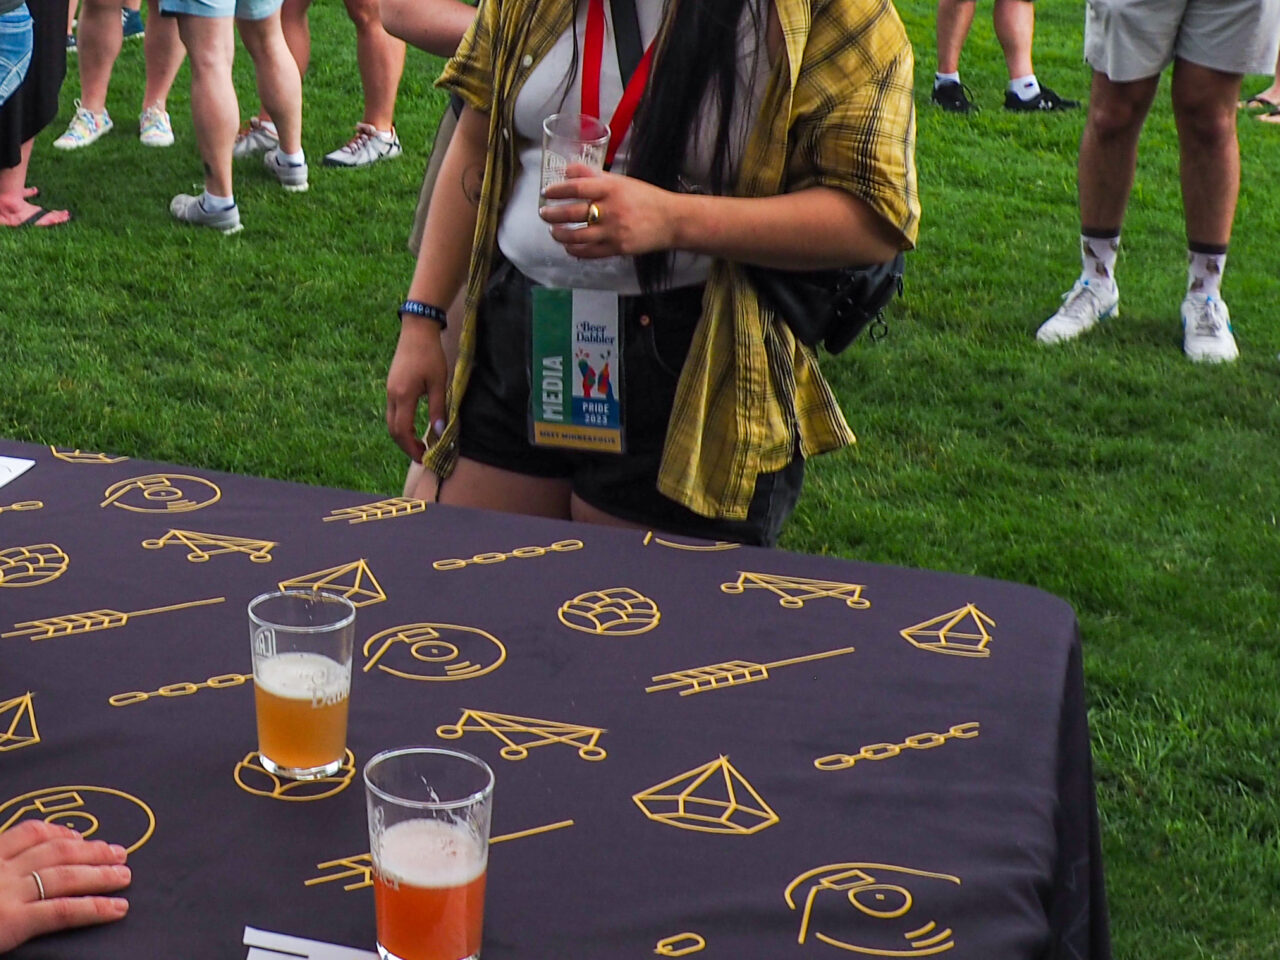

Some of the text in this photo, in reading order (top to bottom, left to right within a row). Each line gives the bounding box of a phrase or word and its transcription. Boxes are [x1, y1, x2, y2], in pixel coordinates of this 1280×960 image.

[583, 321, 607, 333] Beer
[576, 330, 615, 345] Dabbler
[542, 355, 564, 421] MEDIA
[582, 401, 610, 414] PRIDE
[584, 413, 608, 426] 2023
